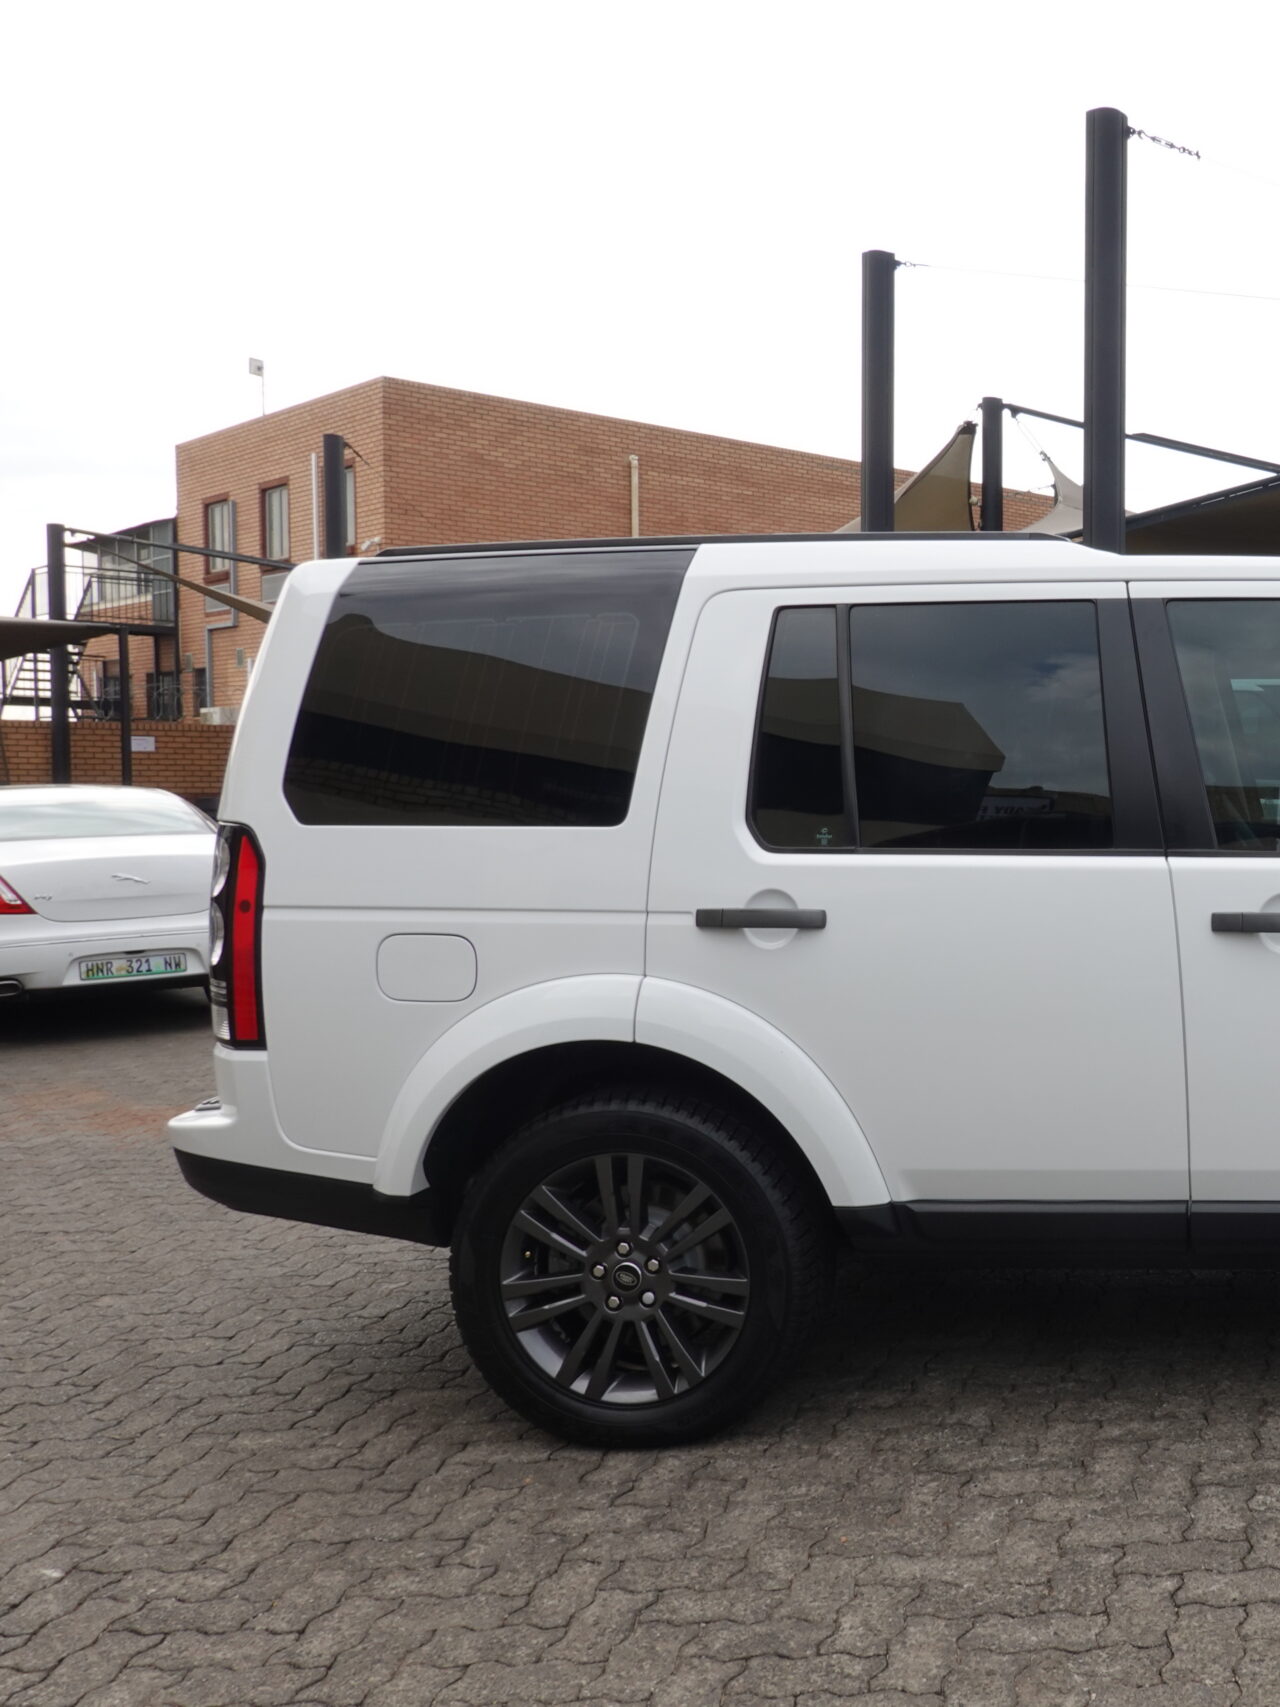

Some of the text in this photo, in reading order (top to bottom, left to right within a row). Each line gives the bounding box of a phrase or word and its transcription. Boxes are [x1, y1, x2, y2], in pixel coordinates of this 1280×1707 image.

[85, 955, 182, 977] HNR 321 NW
